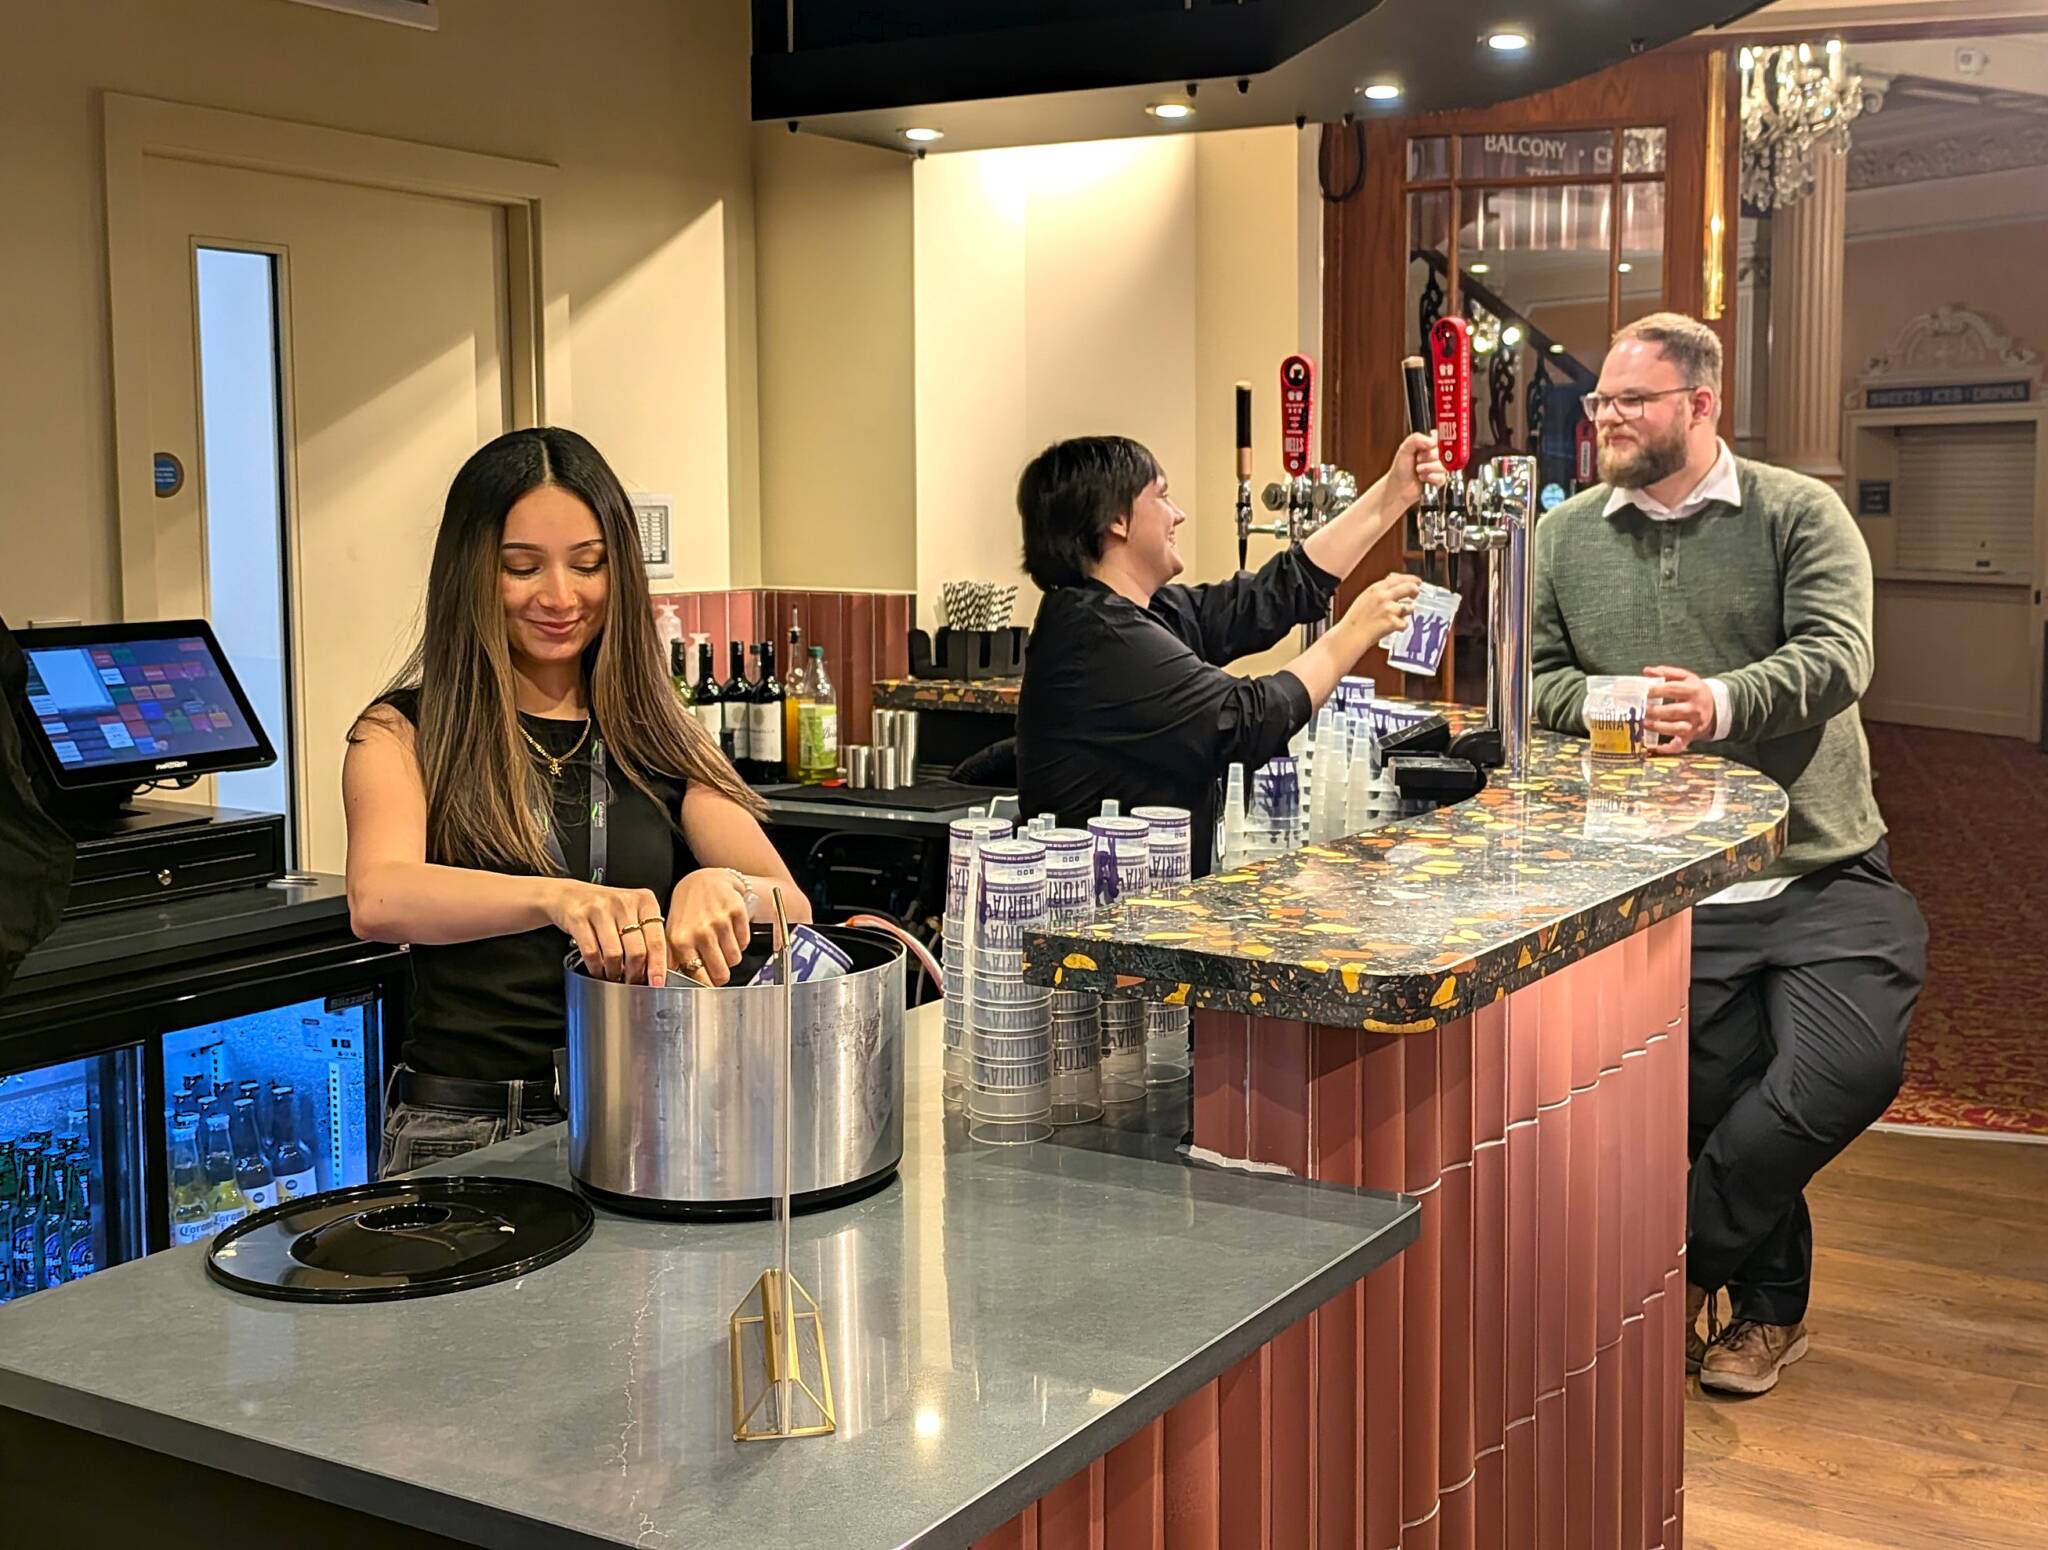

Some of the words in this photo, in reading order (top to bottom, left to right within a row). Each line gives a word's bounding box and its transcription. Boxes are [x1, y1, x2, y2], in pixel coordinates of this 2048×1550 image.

[1485, 134, 1567, 160] BALCONY
[1973, 385, 2025, 402] DRINKS
[993, 892, 1046, 920] ICTORIA
